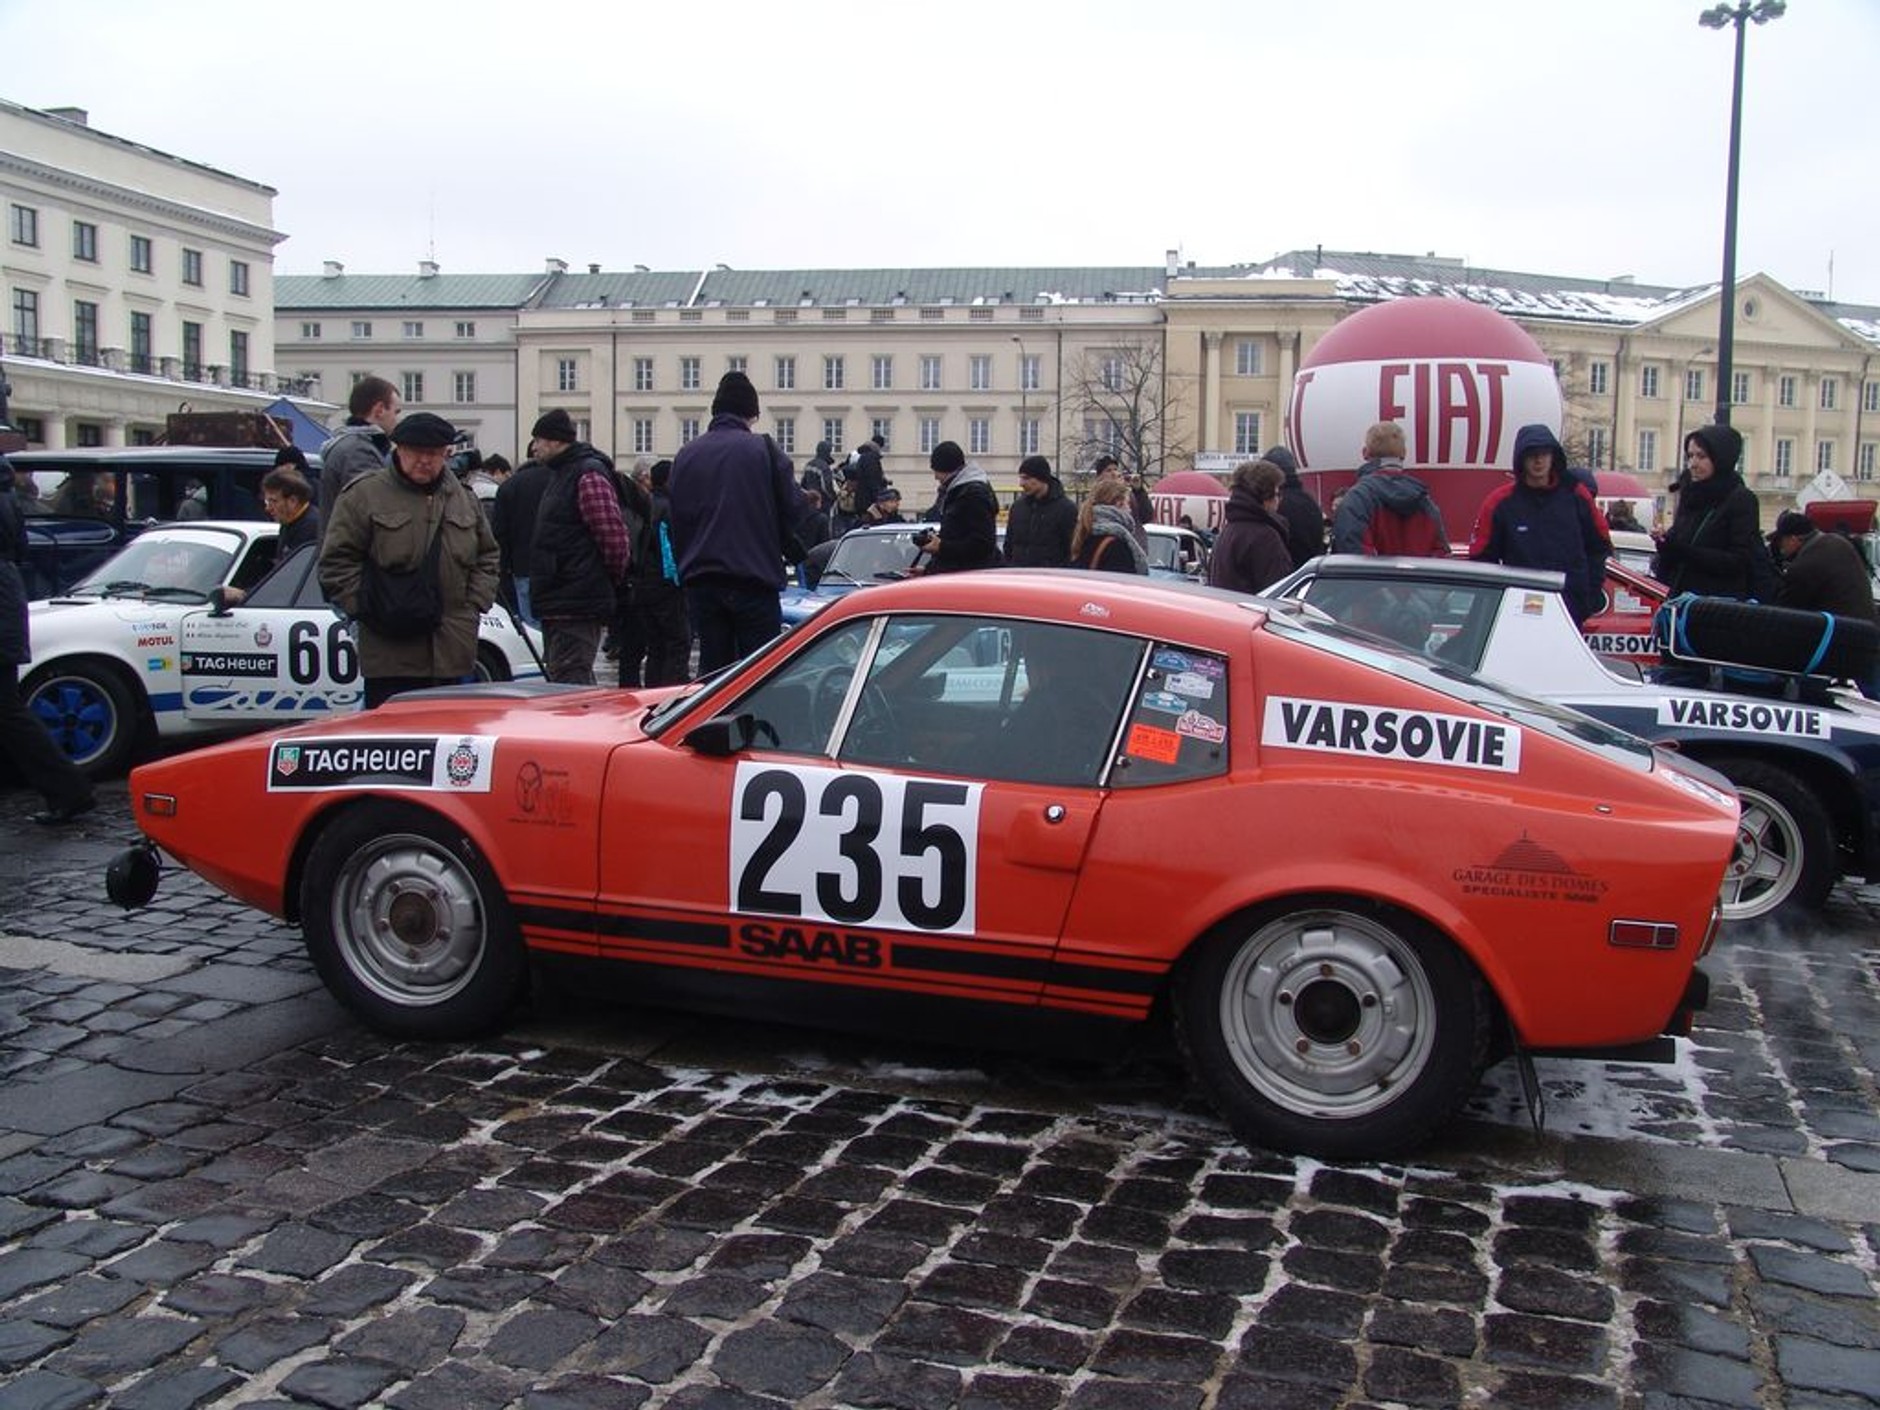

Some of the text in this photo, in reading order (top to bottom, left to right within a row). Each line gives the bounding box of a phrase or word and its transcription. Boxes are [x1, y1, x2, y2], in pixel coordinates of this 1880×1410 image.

[1379, 363, 1510, 465] FIAT
[1151, 496, 1186, 525] IAT
[137, 636, 174, 648] MOTUL
[288, 620, 359, 685] 66
[1281, 702, 1506, 767] VARSOVIE
[1669, 699, 1821, 736] VARSOVIE
[737, 769, 969, 930] 235
[1453, 868, 1514, 886] GARAGE
[740, 923, 882, 969] SAAB
